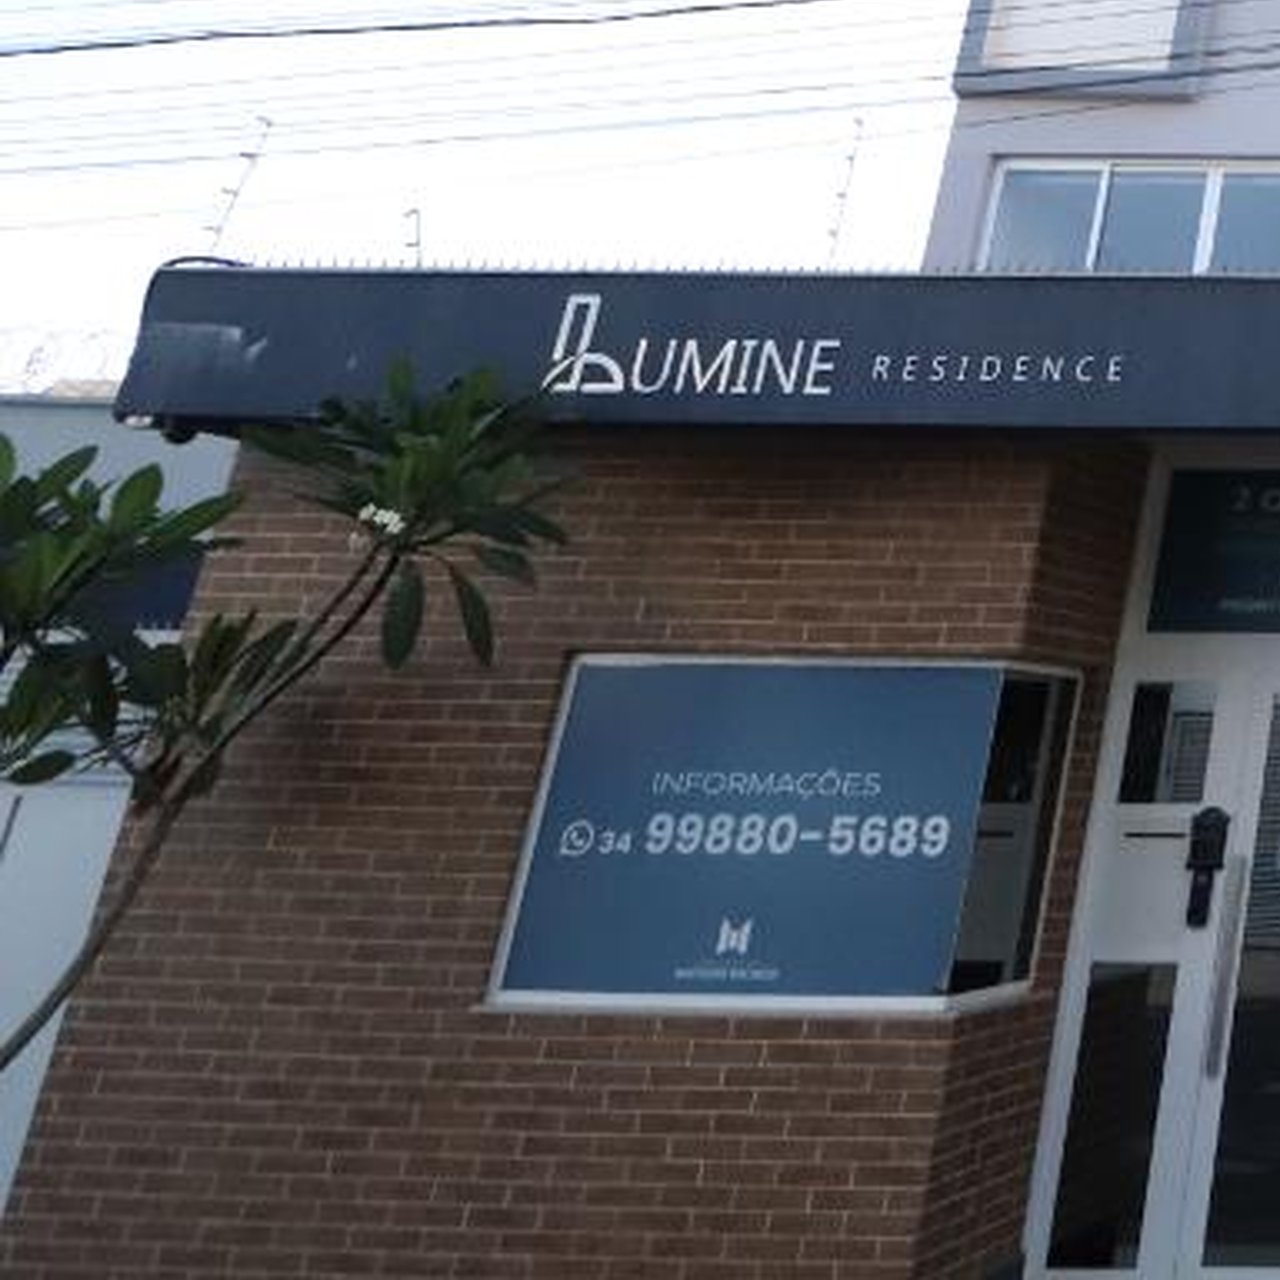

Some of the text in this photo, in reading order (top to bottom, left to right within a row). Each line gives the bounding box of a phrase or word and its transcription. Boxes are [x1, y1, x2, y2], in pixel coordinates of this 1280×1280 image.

[871, 355, 1125, 382] RESIDENCE
[1229, 486, 1252, 513] 2
[651, 767, 882, 800] INFORMAÇÕES
[597, 812, 951, 858] 34 99880-5689
